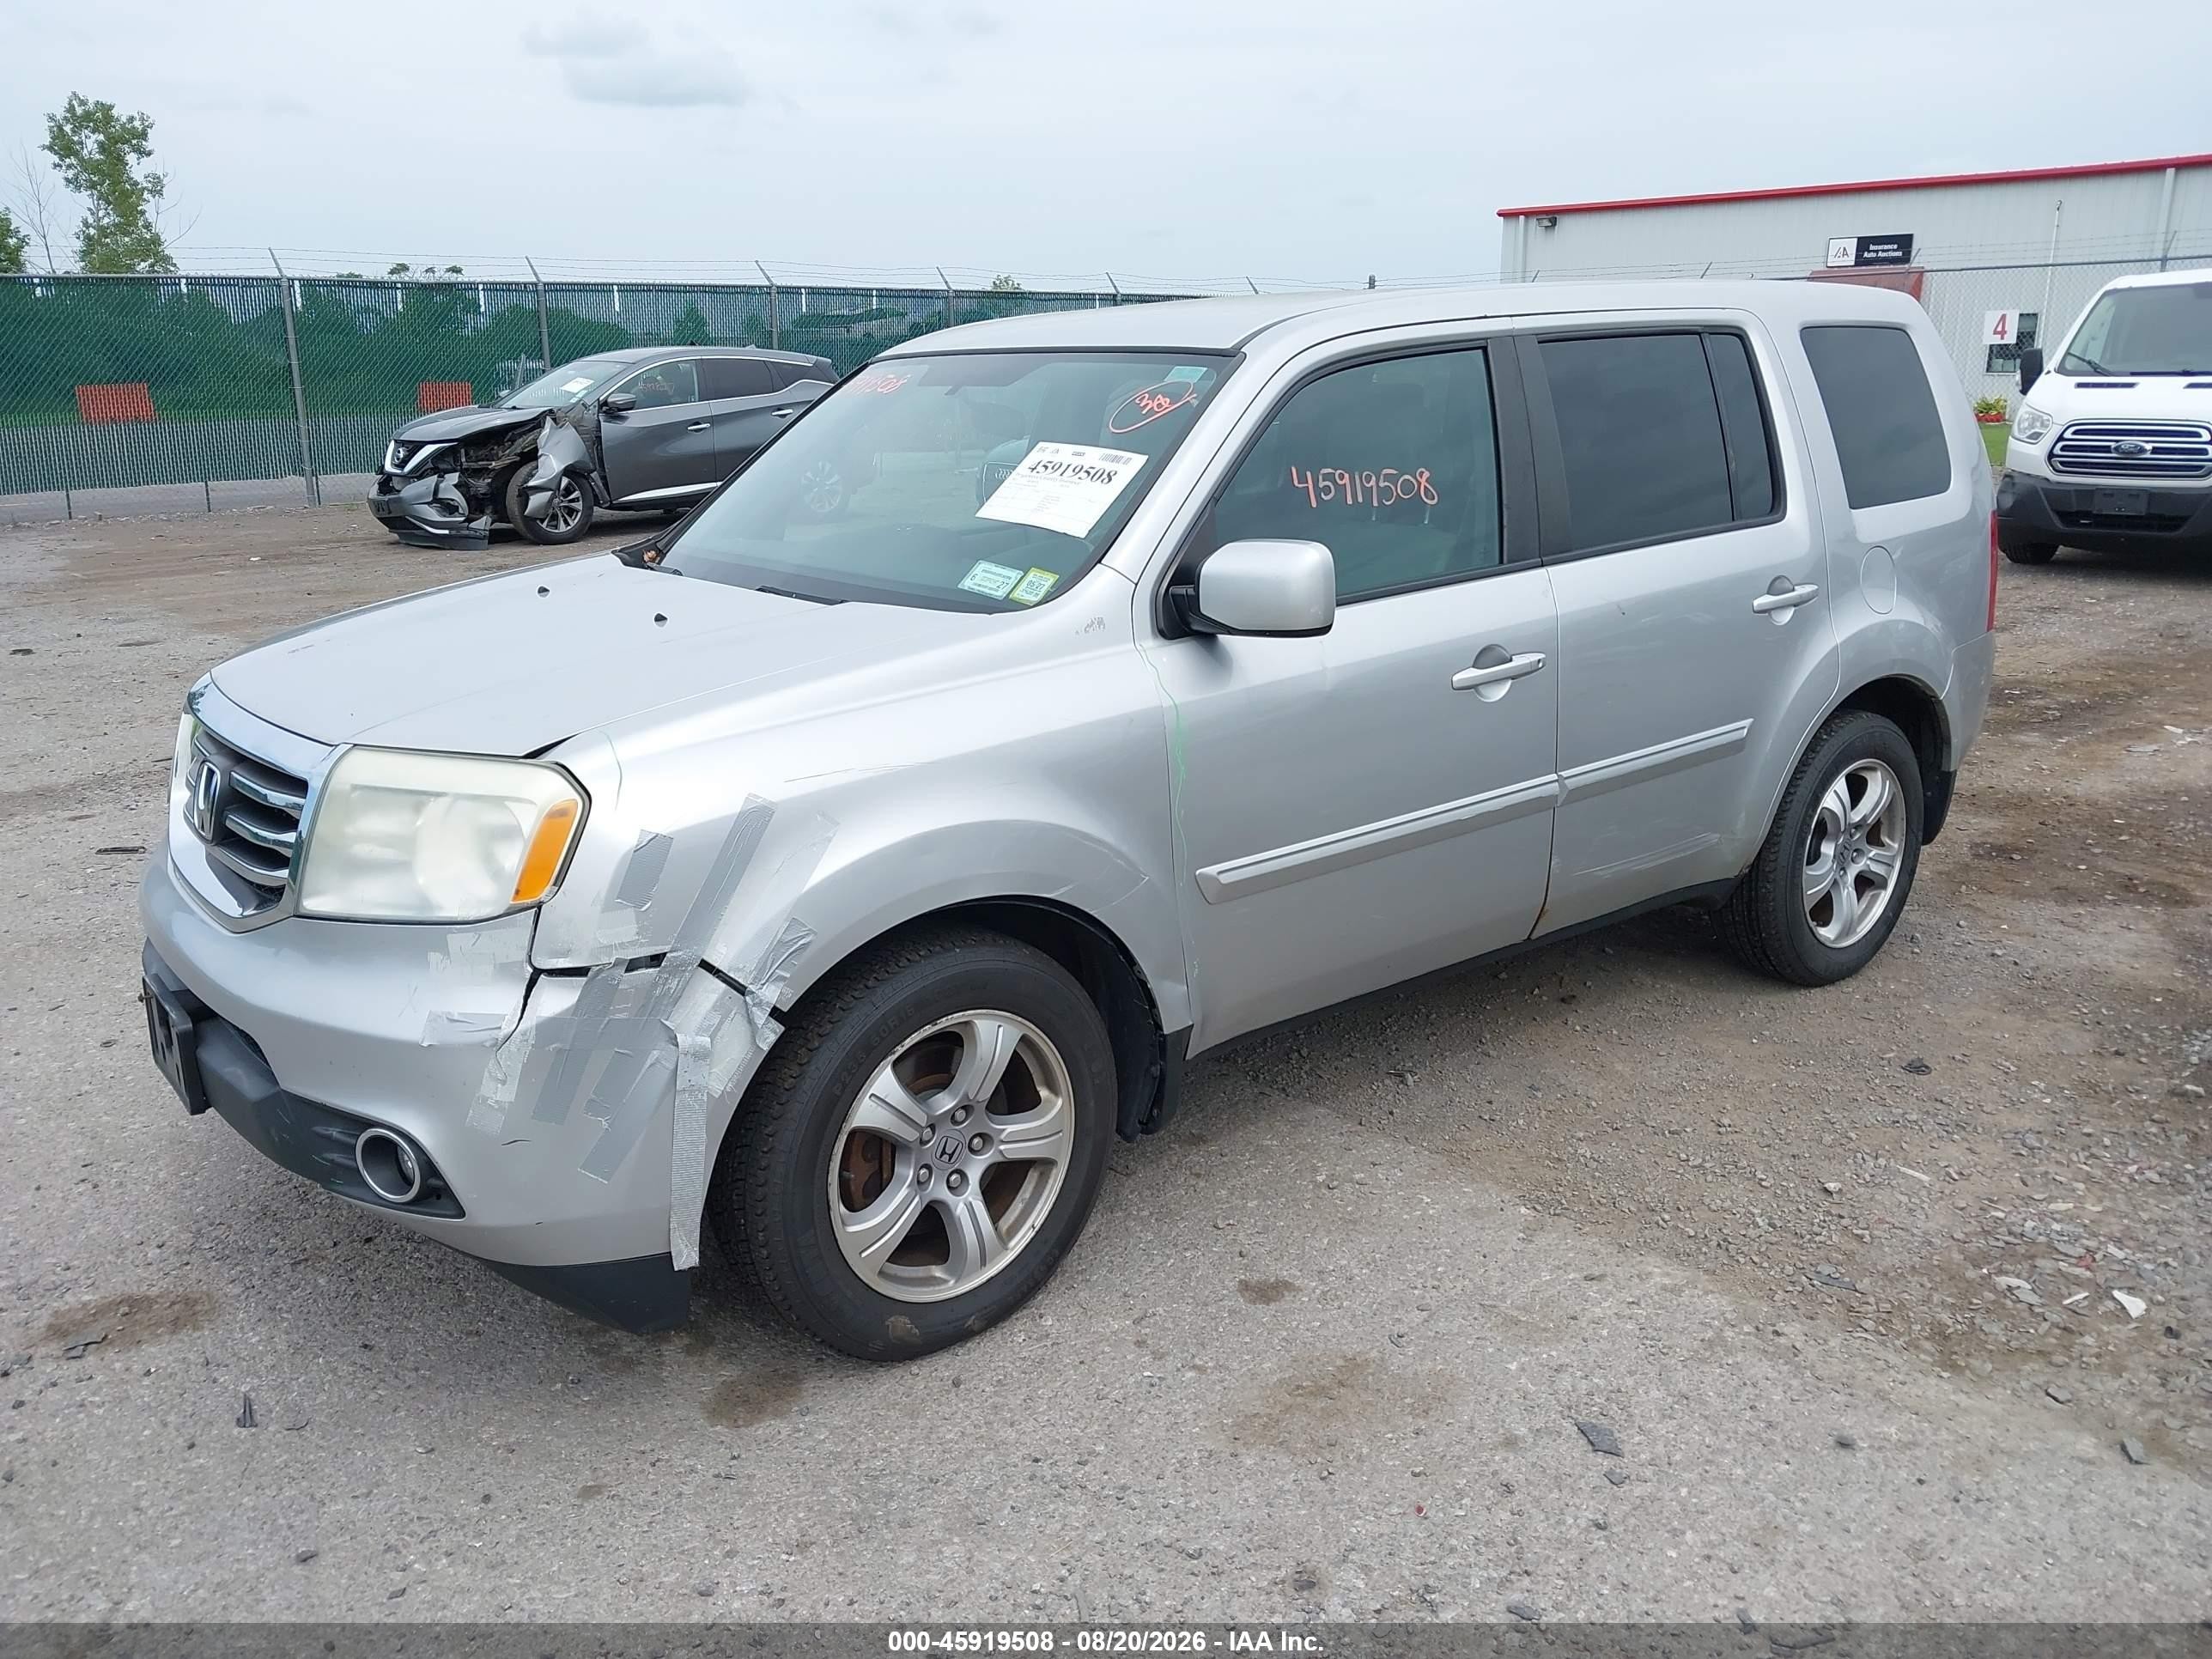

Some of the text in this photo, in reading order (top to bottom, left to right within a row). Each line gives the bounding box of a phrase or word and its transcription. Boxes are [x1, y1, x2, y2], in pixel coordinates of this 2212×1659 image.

[1992, 313, 2008, 341] 4
[1027, 459, 1119, 486] 45919508
[1291, 465, 1439, 508] 45919508
[995, 580, 1010, 591] 27
